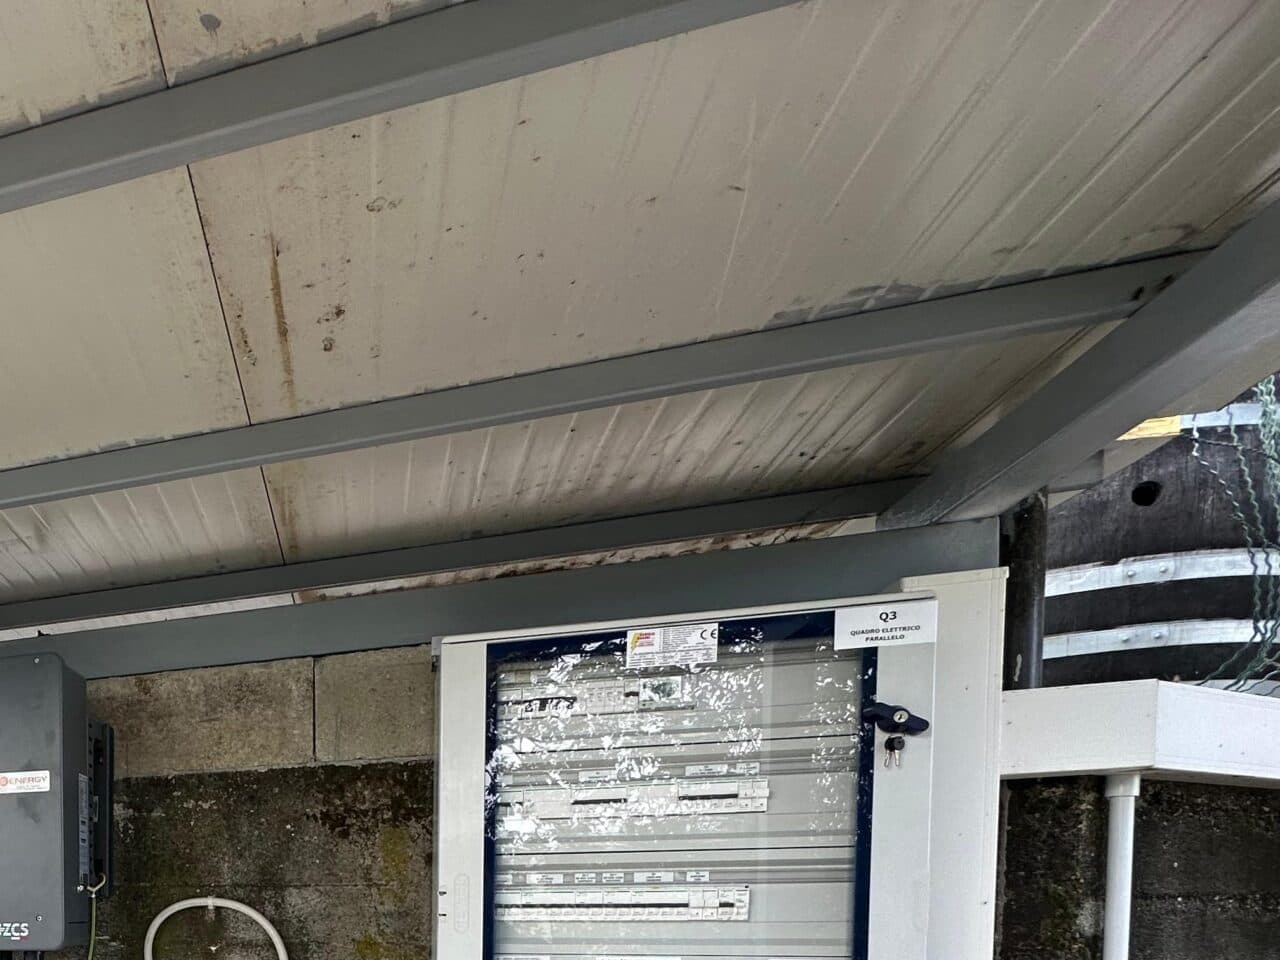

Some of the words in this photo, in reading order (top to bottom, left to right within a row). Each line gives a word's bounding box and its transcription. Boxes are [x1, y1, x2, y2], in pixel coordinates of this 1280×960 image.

[879, 611, 897, 623] Q3
[850, 628, 880, 636] QUADRO
[881, 625, 921, 634] ELETTRICO
[864, 634, 905, 642] PARALLELO
[9, 776, 48, 785] ENERGY
[2, 922, 29, 937] ZCS
